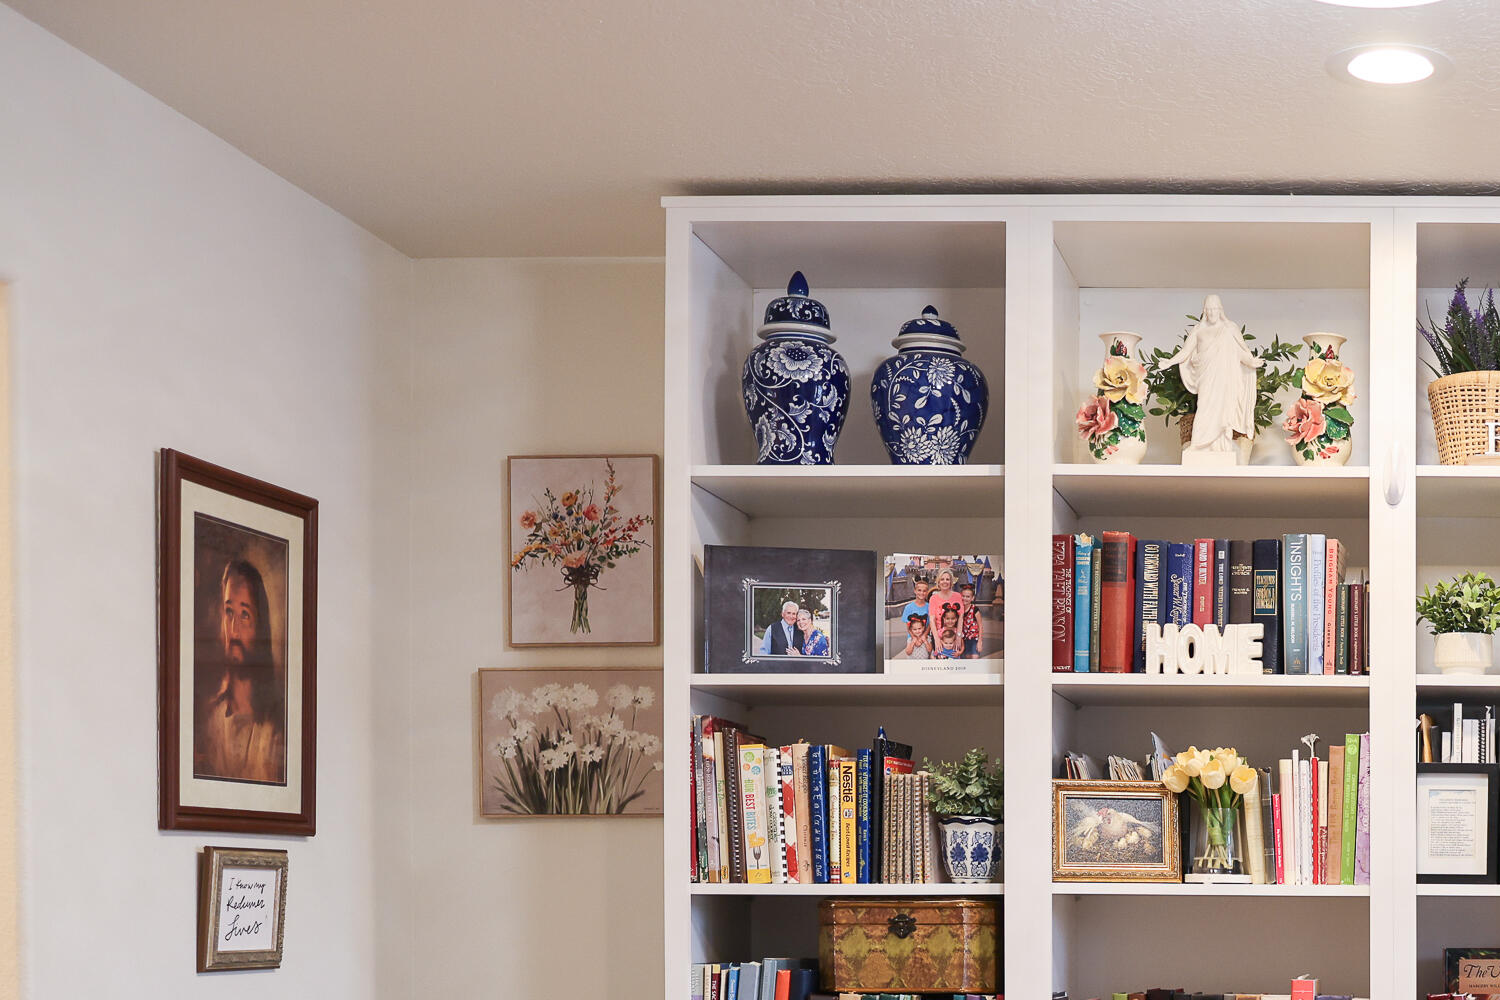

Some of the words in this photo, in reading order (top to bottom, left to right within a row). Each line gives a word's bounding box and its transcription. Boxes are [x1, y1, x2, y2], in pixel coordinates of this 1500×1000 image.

[1142, 544, 1160, 553] GO
[1142, 554, 1160, 580] FORWARD
[1290, 541, 1303, 601] INSIGHTS
[1313, 560, 1321, 587] Profiles
[1142, 582, 1160, 600] WITH
[1313, 589, 1321, 598] of
[1142, 600, 1160, 620] FAITH
[1313, 602, 1321, 612] the
[1313, 613, 1321, 652] Presidents
[1146, 623, 1264, 674] HOME
[744, 780, 754, 792] OUR
[843, 766, 853, 802] Nestlé
[745, 793, 756, 810] BEST
[746, 812, 756, 830] BITES
[228, 878, 235, 890] I
[236, 880, 253, 890] know
[254, 882, 266, 894] my
[225, 914, 262, 941] Lives
[1464, 964, 1487, 978] The
